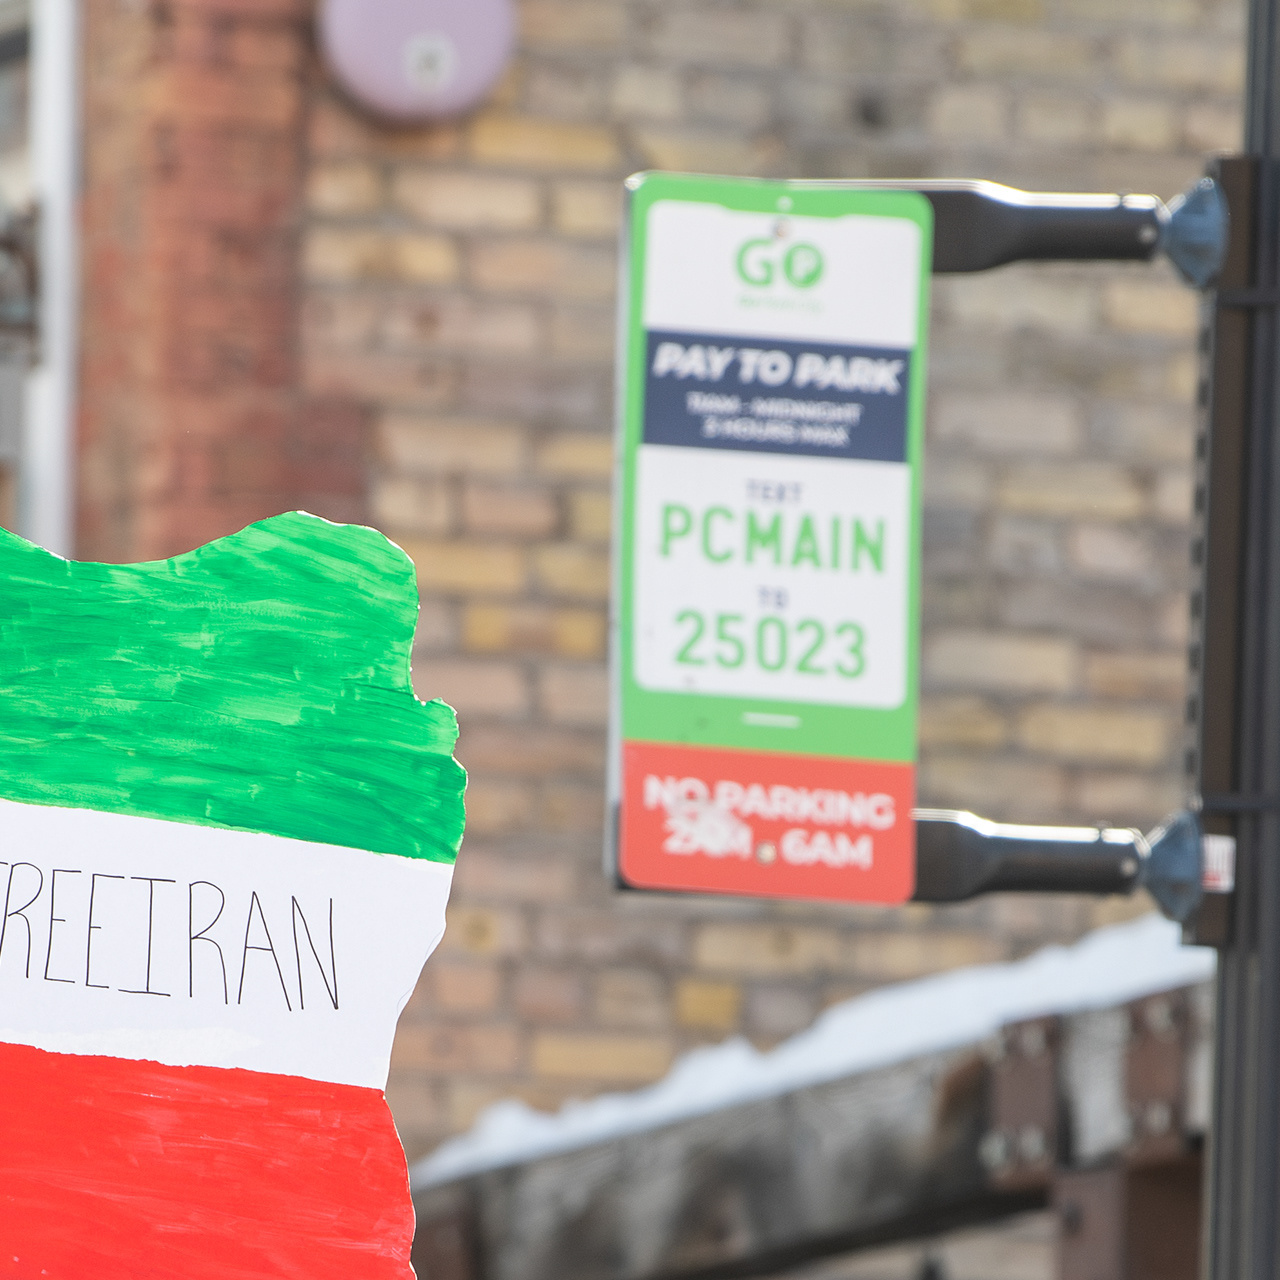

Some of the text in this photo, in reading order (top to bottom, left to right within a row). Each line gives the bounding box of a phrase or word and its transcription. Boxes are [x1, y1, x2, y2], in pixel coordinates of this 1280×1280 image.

[736, 238, 825, 289] GO
[652, 342, 904, 396] PAY TO PARK
[720, 416, 797, 445] HOURS
[797, 421, 851, 448] MAX
[749, 396, 864, 427] MIDNIGHT
[745, 478, 803, 503] TEXT
[659, 504, 886, 574] PCMAIN
[757, 585, 789, 611] TO
[674, 609, 868, 680] 25023
[643, 774, 896, 830] NO PARKING
[663, 815, 874, 870] 2M 6AM
